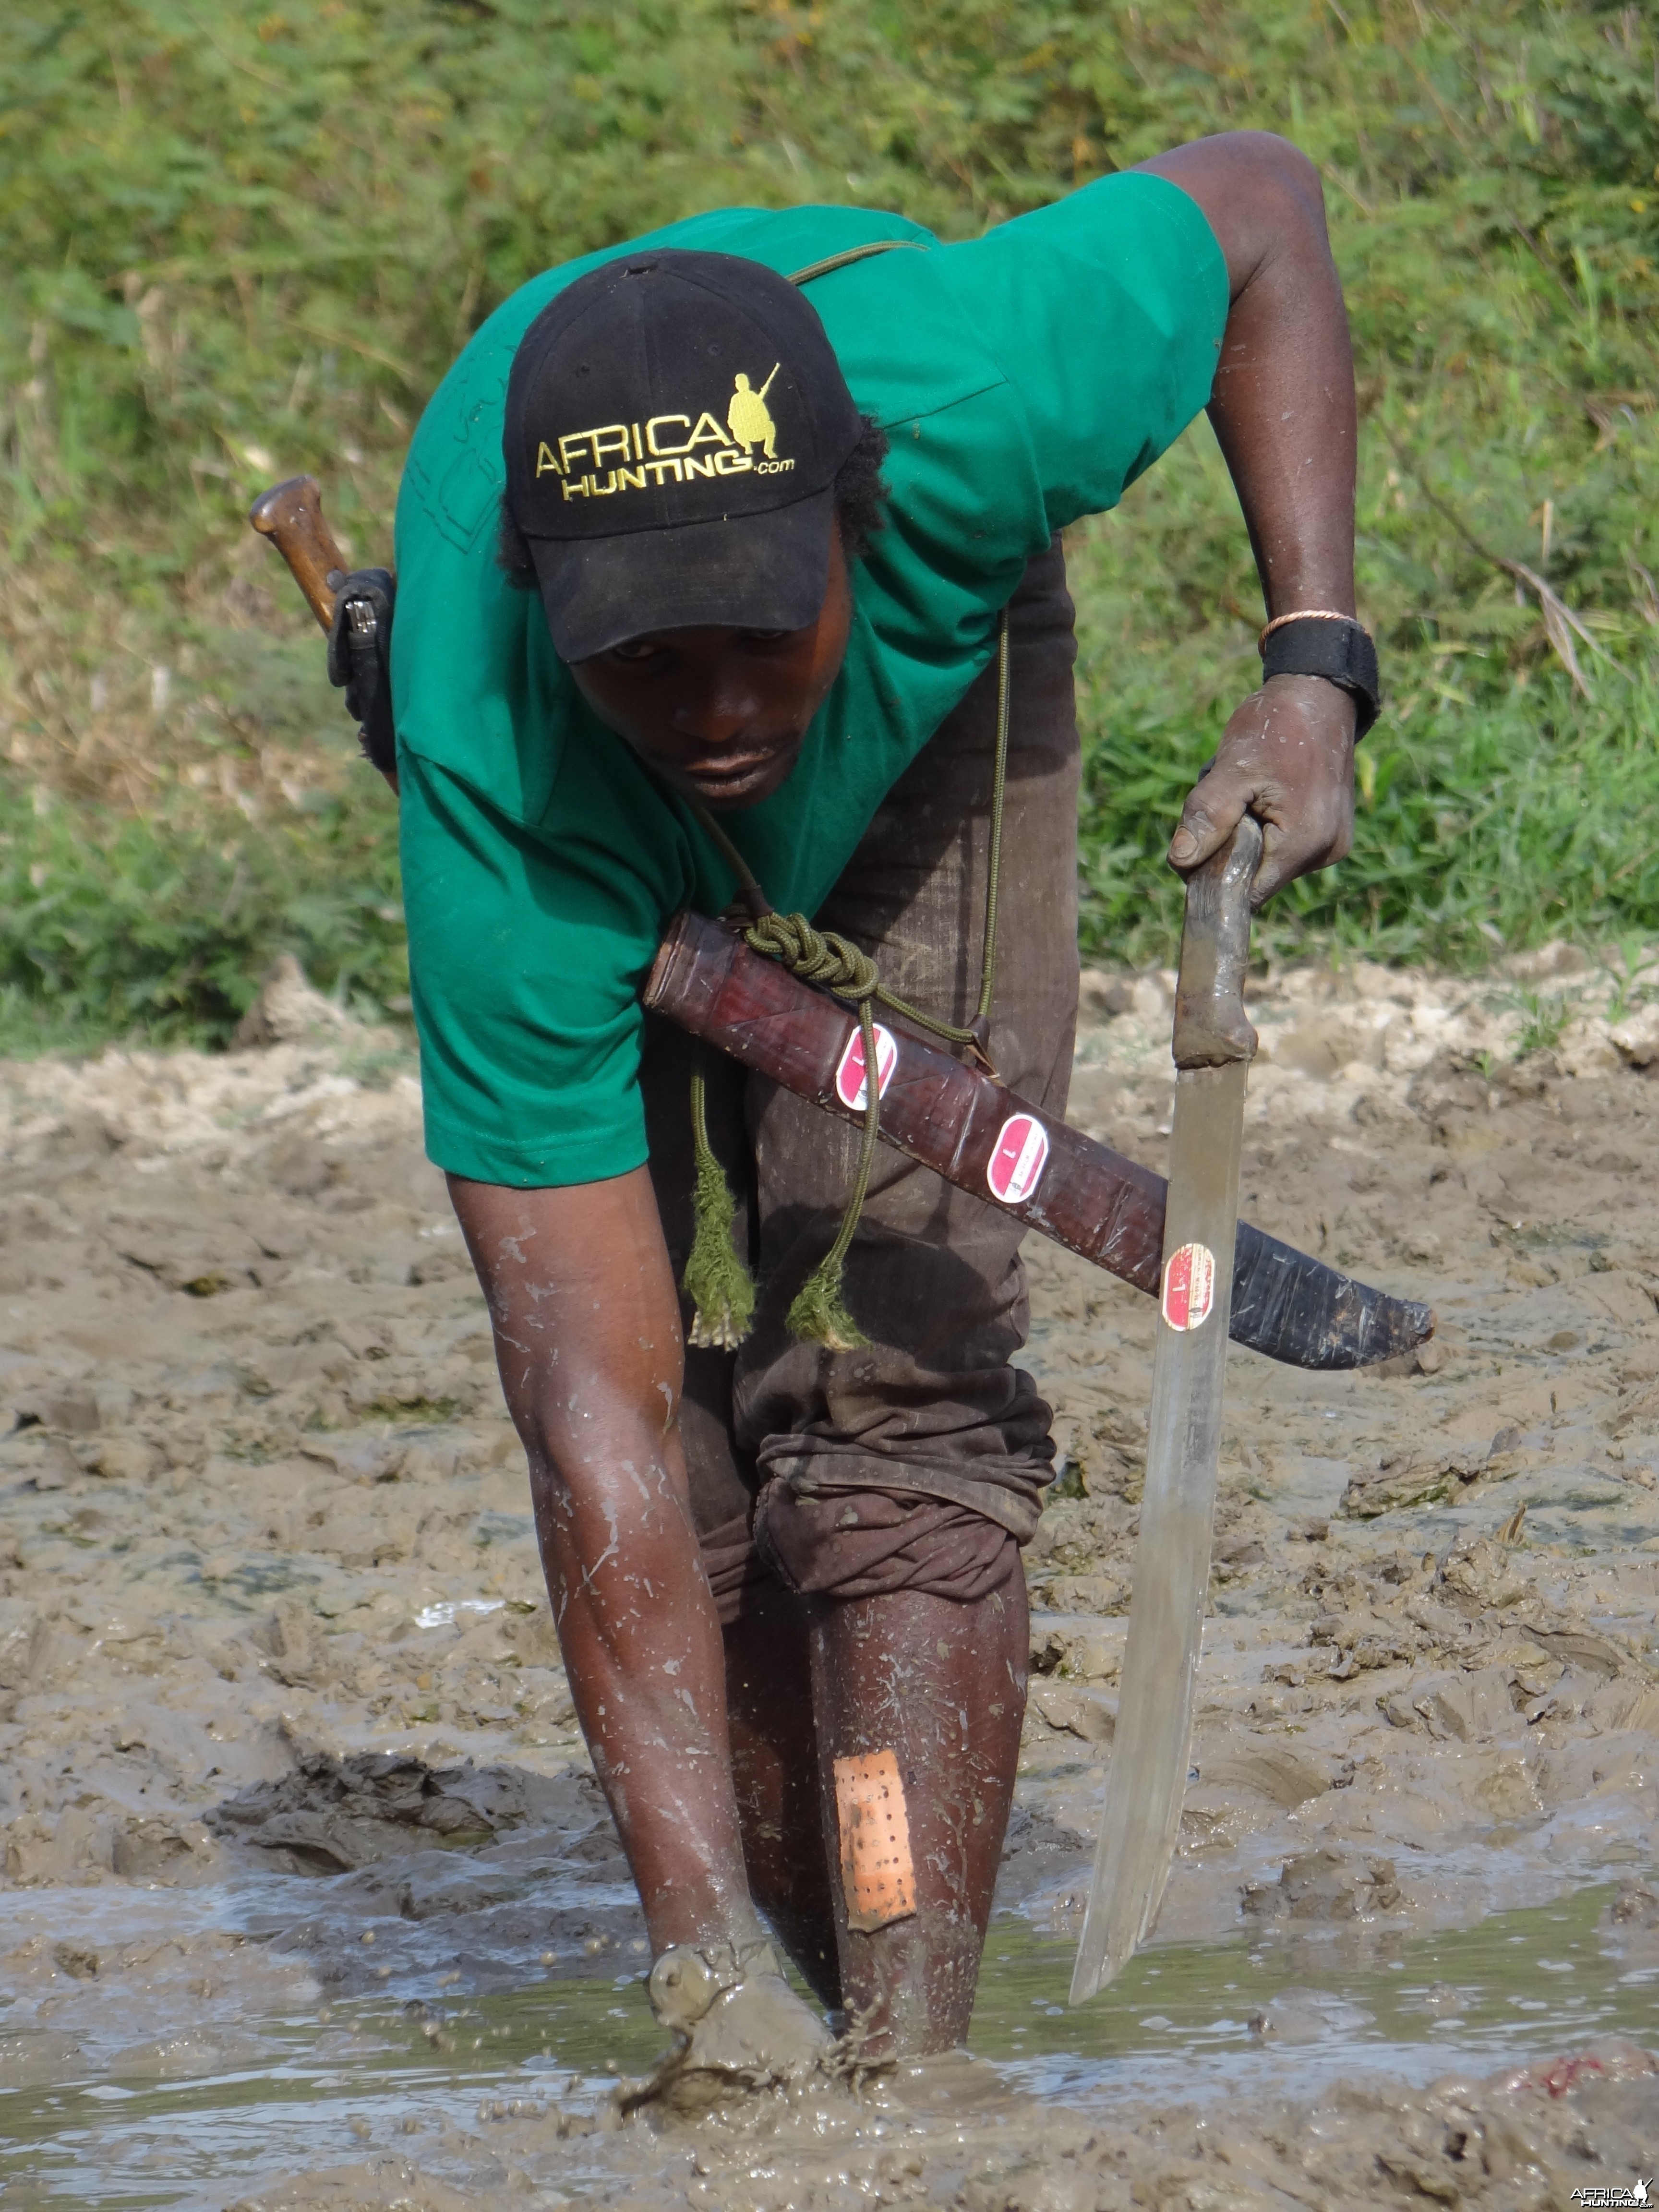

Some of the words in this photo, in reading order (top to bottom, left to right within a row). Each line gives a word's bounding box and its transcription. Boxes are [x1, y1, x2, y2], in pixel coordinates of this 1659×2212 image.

[536, 412, 734, 478] AFRICA
[1002, 1149, 1016, 1159] L
[1172, 1284, 1186, 1292] L
